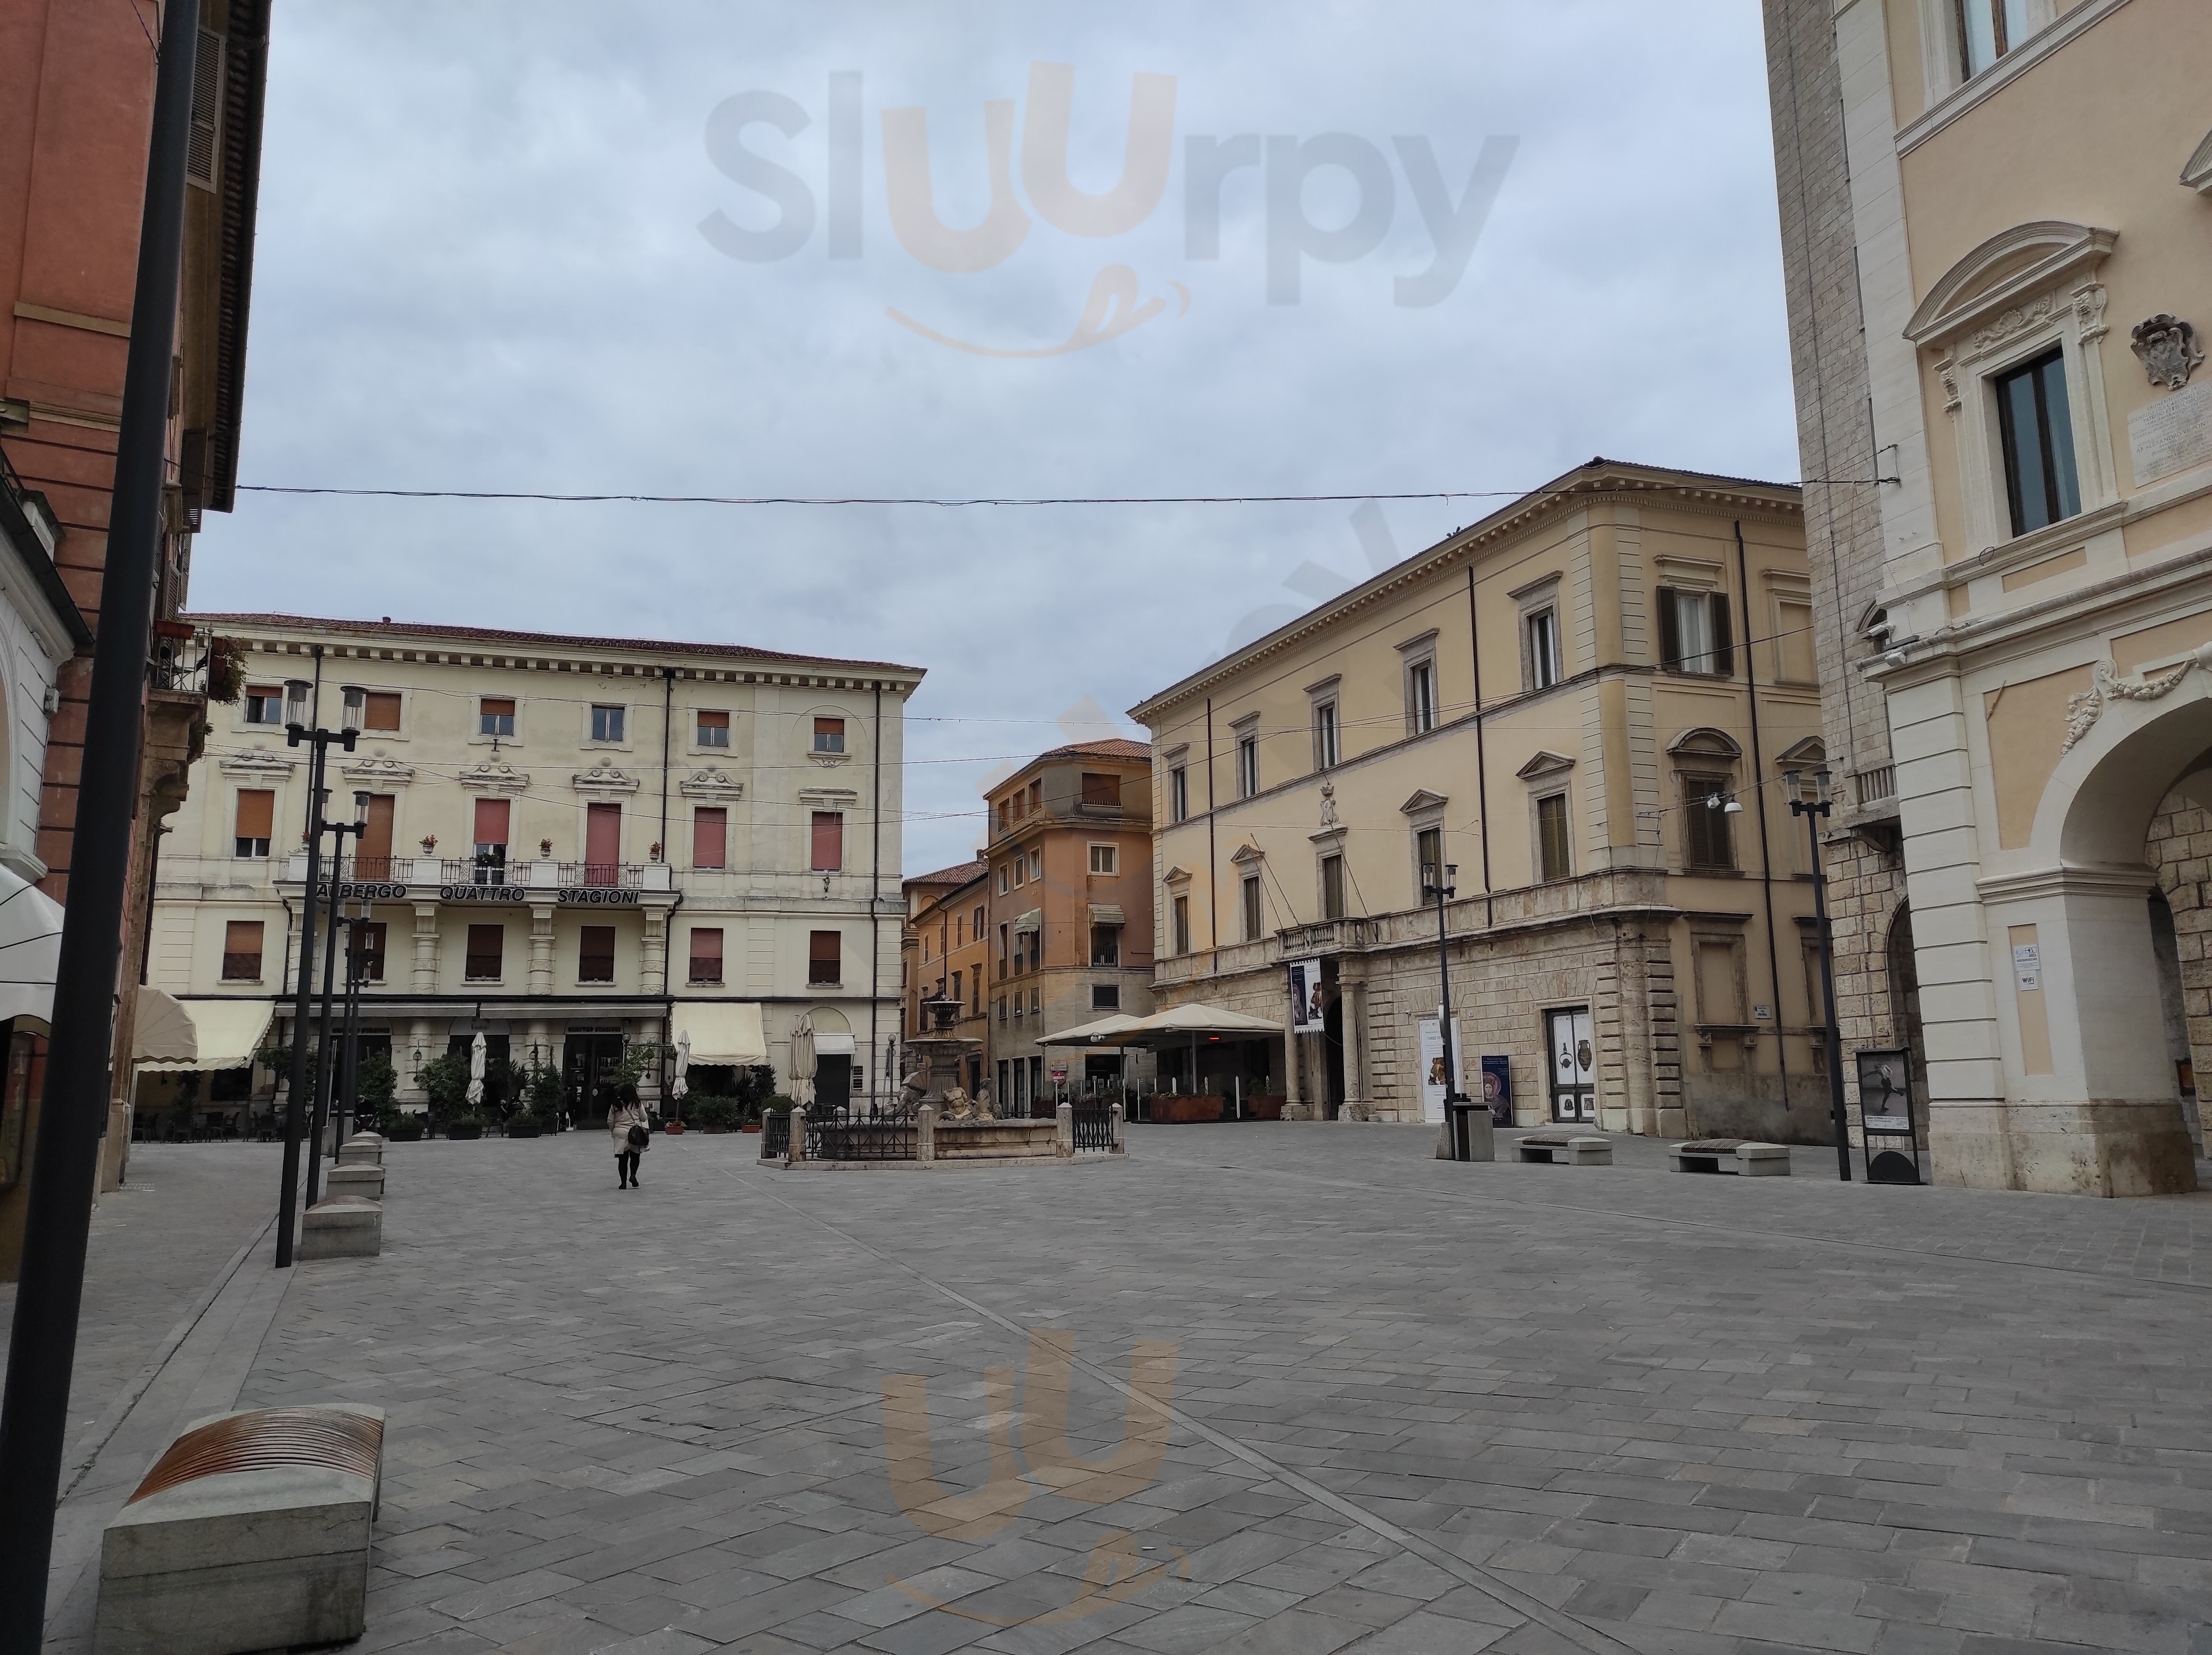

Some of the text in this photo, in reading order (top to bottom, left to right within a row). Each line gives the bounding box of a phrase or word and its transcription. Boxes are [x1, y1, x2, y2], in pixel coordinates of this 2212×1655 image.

[317, 884, 639, 904] ABERGO QUATTRO STAGIONI
